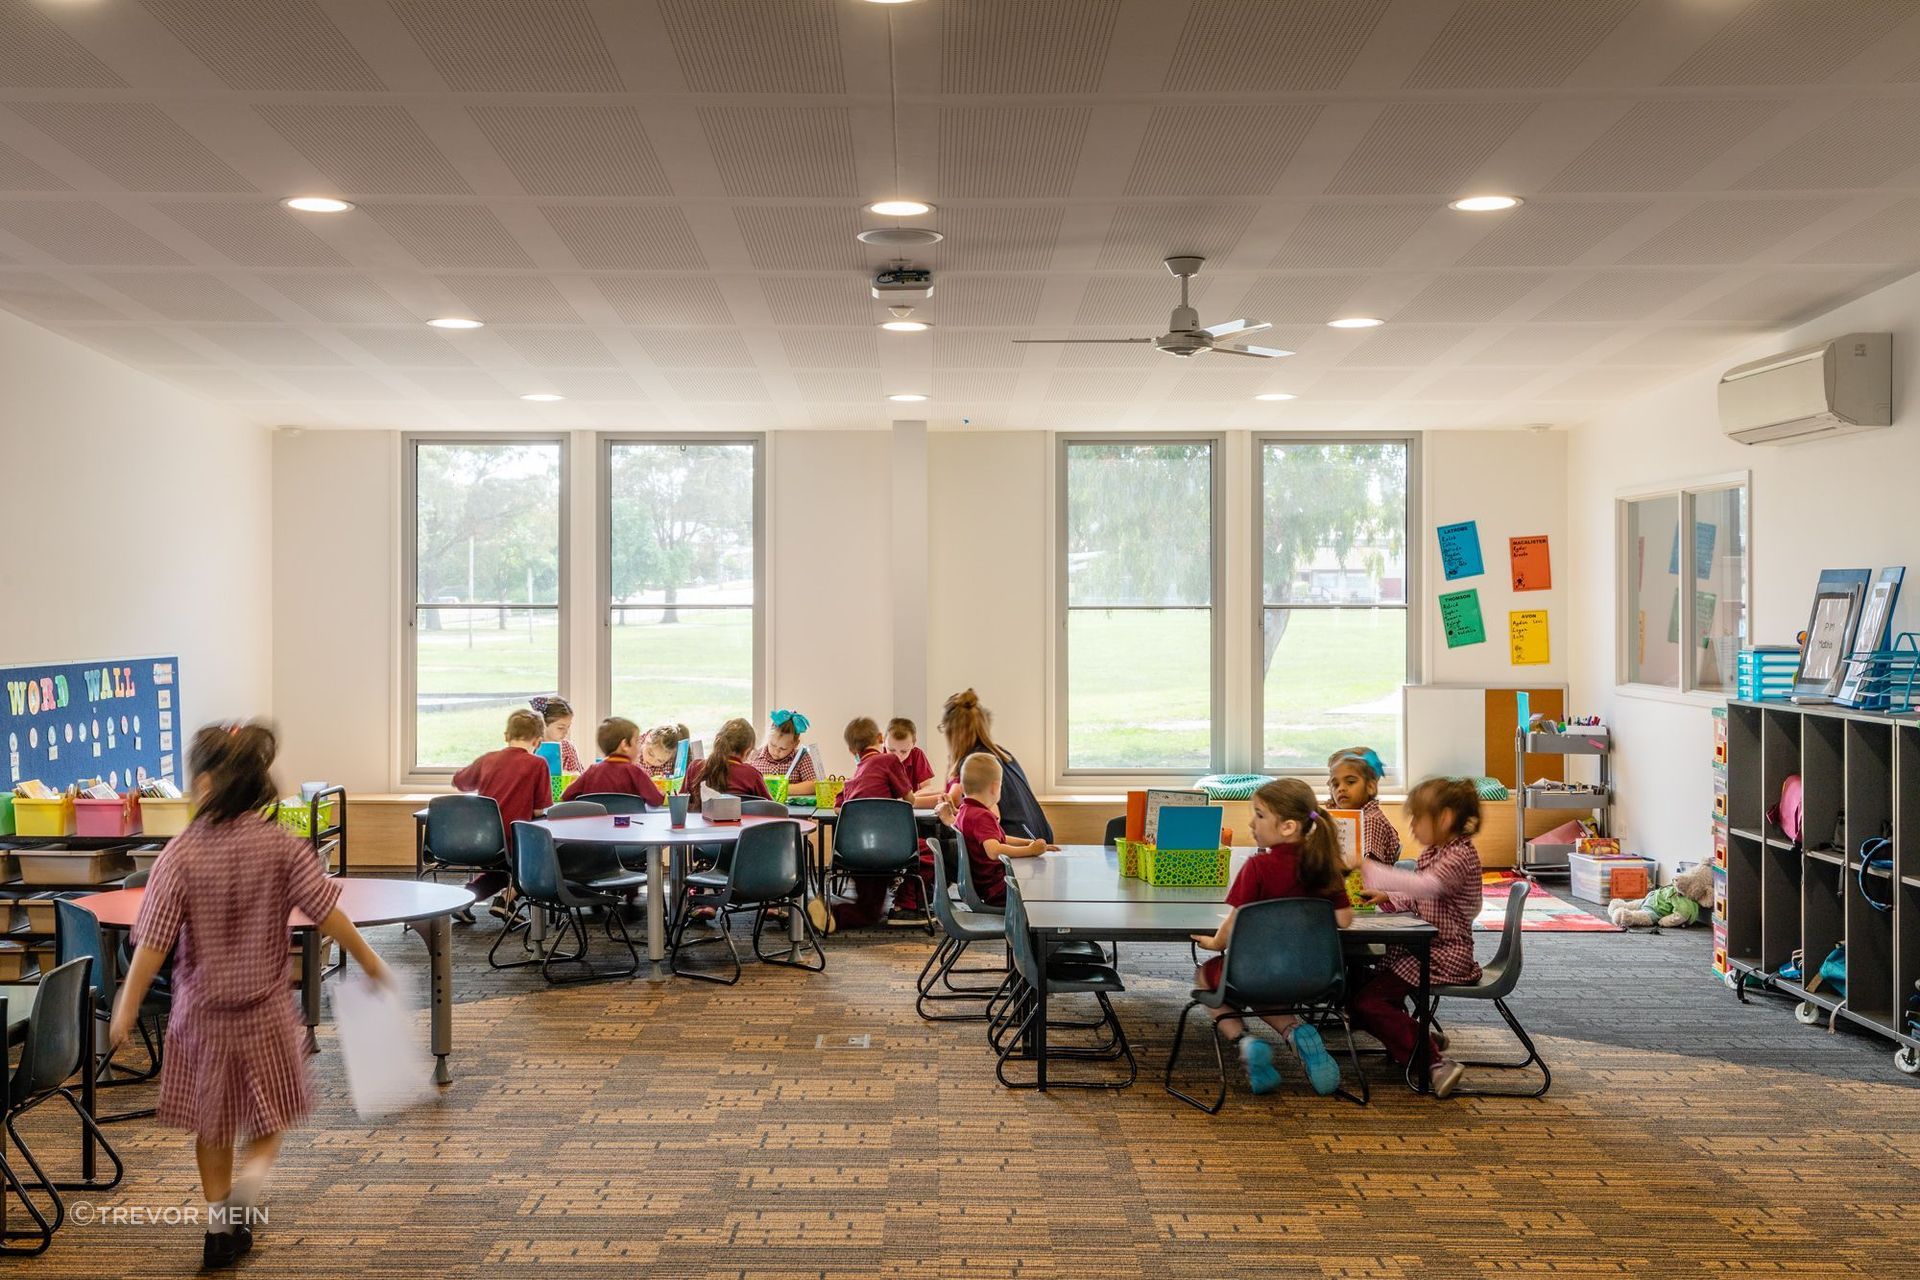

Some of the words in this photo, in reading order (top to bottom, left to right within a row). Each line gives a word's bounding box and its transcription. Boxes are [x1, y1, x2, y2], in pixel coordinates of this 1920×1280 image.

[1445, 594, 1471, 602] THOMSON
[7, 674, 70, 716] WORD
[84, 667, 136, 702] WALL
